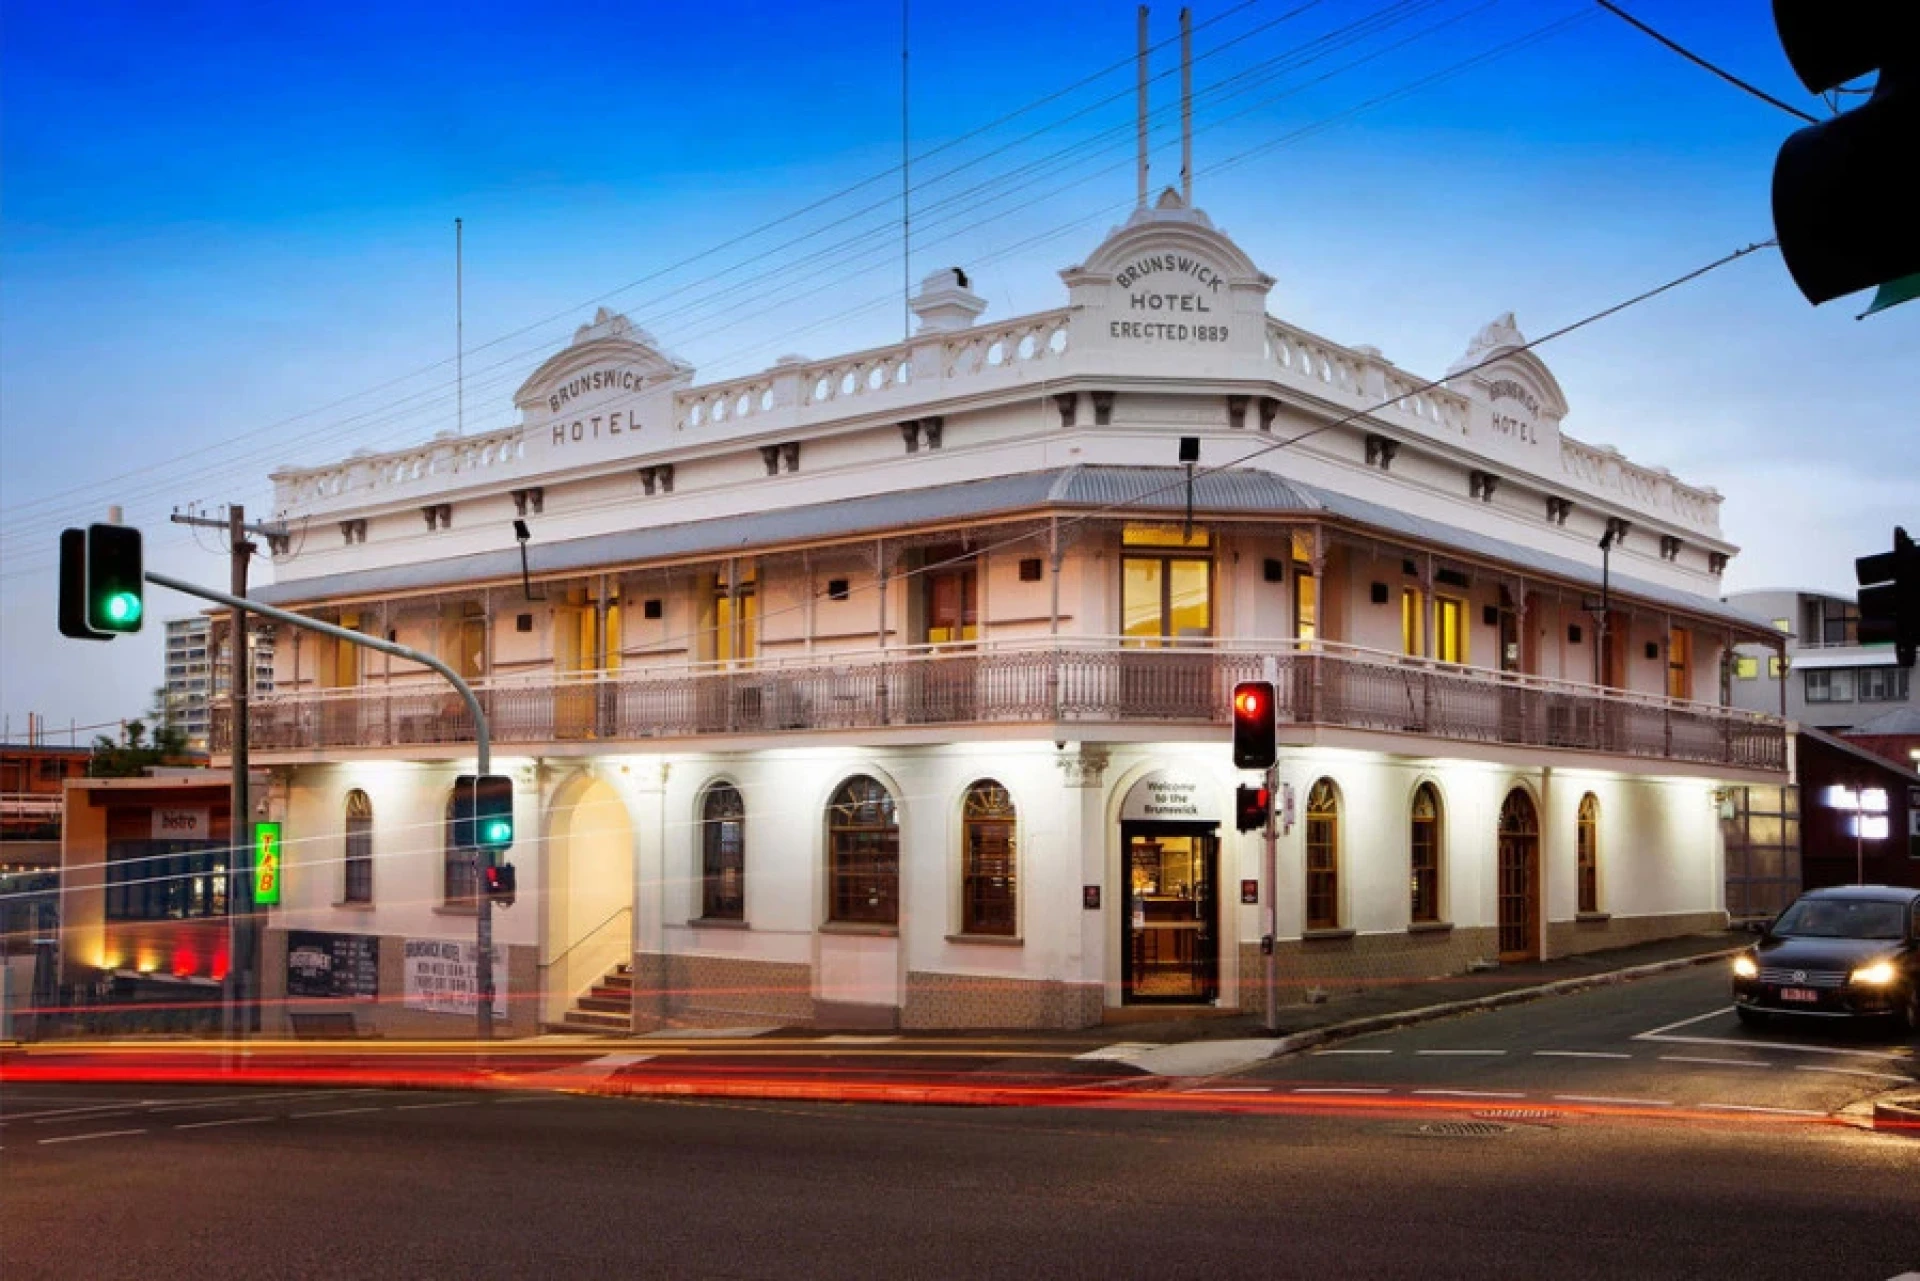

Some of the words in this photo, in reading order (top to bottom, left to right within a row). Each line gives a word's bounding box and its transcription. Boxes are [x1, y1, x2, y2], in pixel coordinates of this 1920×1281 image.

[1116, 253, 1223, 293] BRUNSWICK
[1131, 294, 1210, 312] HOTEL
[1110, 321, 1188, 341] ERECTED
[1192, 325, 1229, 342] 1889
[548, 368, 644, 413] BRUNSWICK
[552, 409, 642, 445] HOTEL
[1492, 411, 1538, 445] HOTEL
[1147, 781, 1196, 792] Welcome
[1155, 794, 1167, 804] to
[1170, 793, 1188, 804] the
[161, 810, 198, 830] bistro
[1144, 804, 1198, 815] Brunswick
[259, 833, 275, 893] TAB
